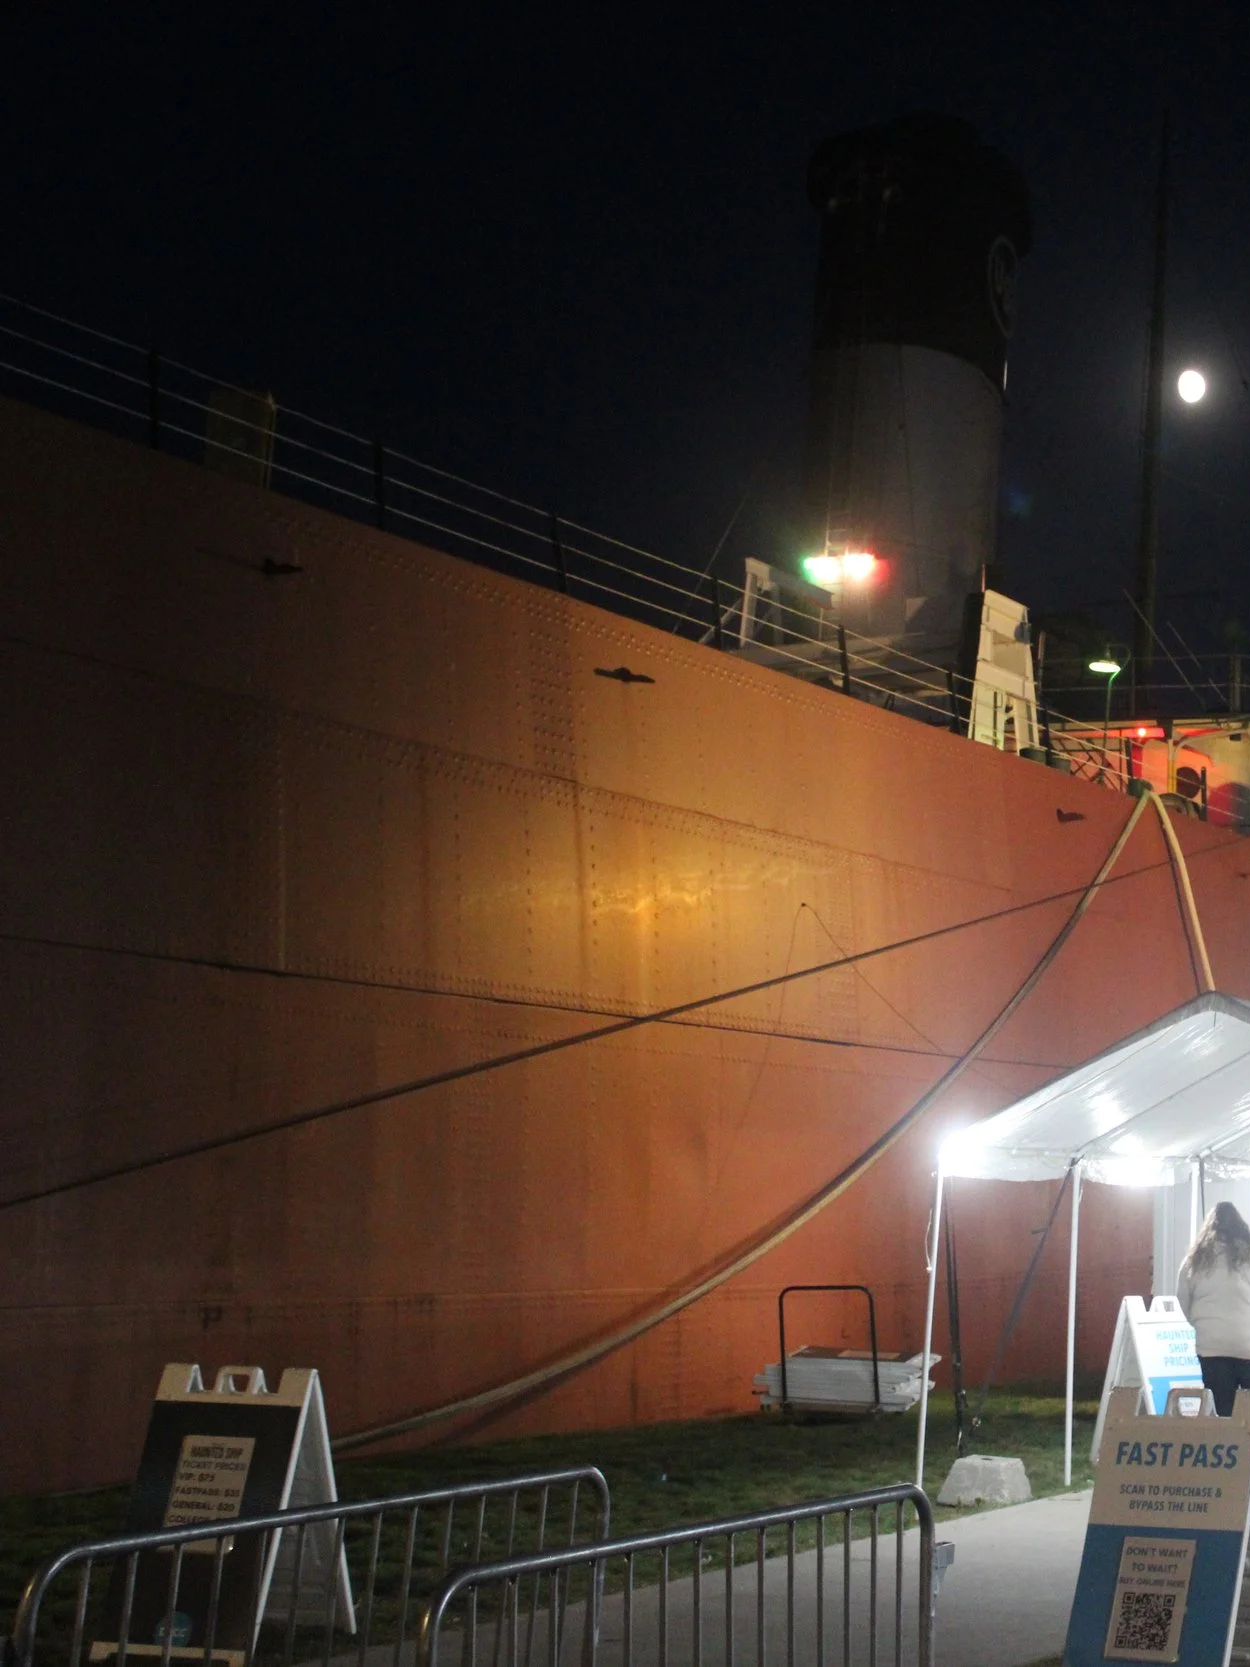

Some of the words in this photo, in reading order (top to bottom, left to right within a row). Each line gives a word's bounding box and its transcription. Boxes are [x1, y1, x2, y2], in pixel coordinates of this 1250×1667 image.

[1156, 1329, 1196, 1340] HAUNTED
[1168, 1343, 1189, 1353] SHIP
[1163, 1355, 1200, 1367] PRICING
[1115, 1441, 1173, 1466] FAST
[1178, 1443, 1239, 1469] PASS
[1119, 1484, 1145, 1495] SCAN
[1148, 1485, 1159, 1496] TO
[1162, 1486, 1213, 1498] PURCHASE
[1215, 1488, 1222, 1498] &
[1128, 1499, 1164, 1511] BYPASS
[1168, 1501, 1184, 1512] THE
[1187, 1502, 1208, 1513] LINE
[1126, 1547, 1157, 1557] DON'T
[1158, 1548, 1188, 1558] WANT
[1132, 1562, 1145, 1572] TO
[1147, 1563, 1179, 1574] WAIT?
[1119, 1577, 1135, 1585] BUY
